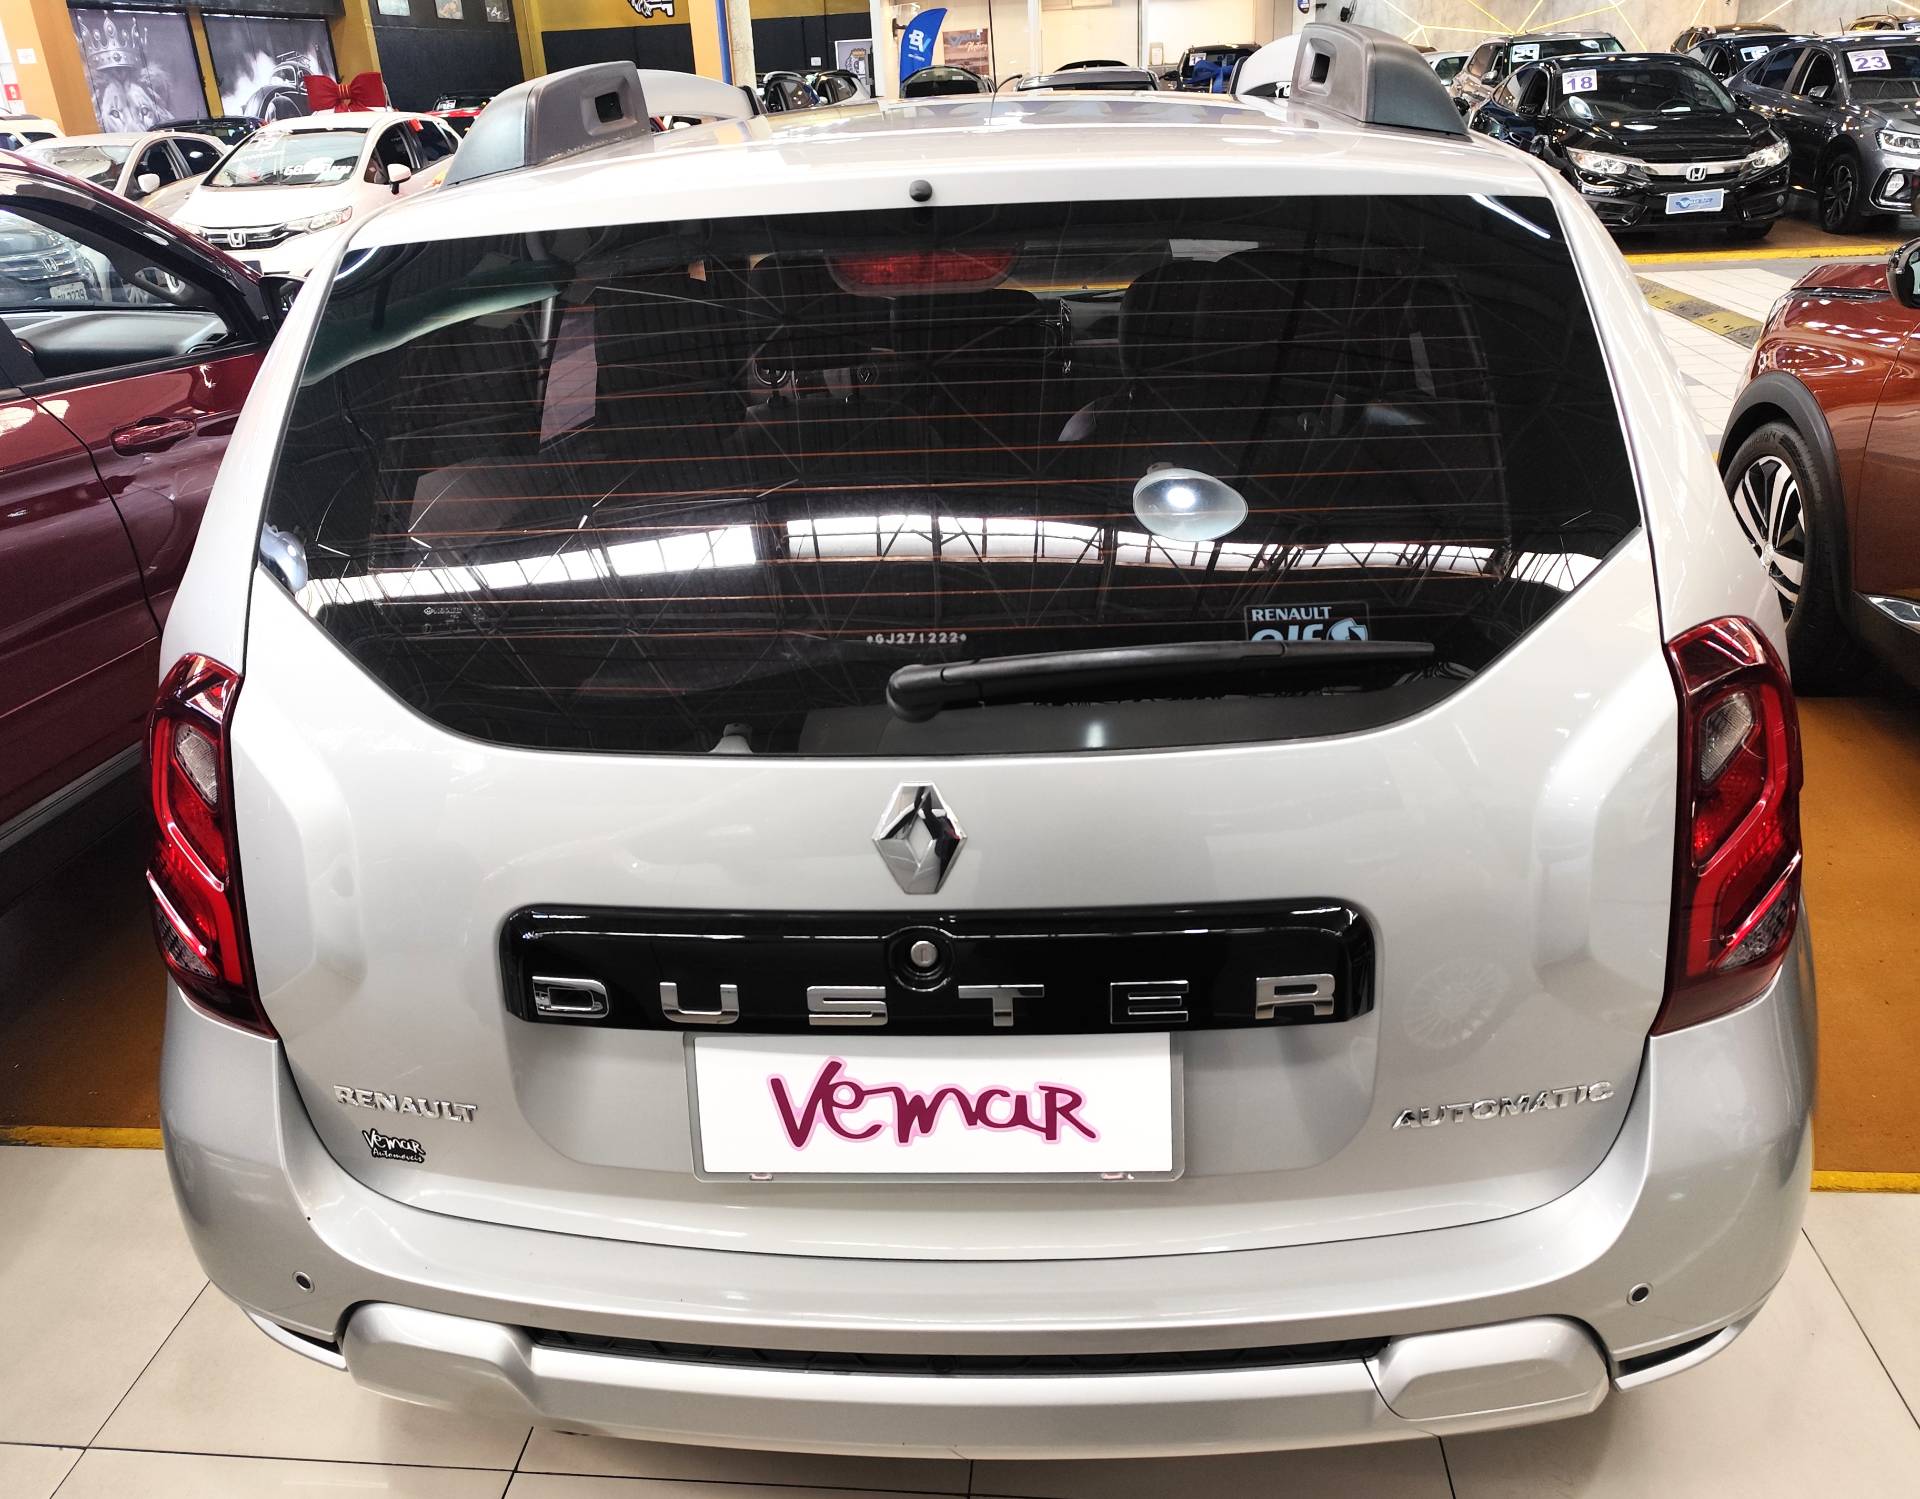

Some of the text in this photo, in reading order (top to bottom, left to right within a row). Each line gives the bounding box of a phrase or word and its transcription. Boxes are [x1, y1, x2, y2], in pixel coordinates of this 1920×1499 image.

[1855, 57, 1887, 70] 23
[1567, 76, 1593, 91] 18
[1252, 606, 1332, 622] RENAULT
[532, 973, 1336, 1025] DUSTER
[333, 1084, 478, 1123] RENAULT
[1392, 1080, 1615, 1130] AUTOMATIC
